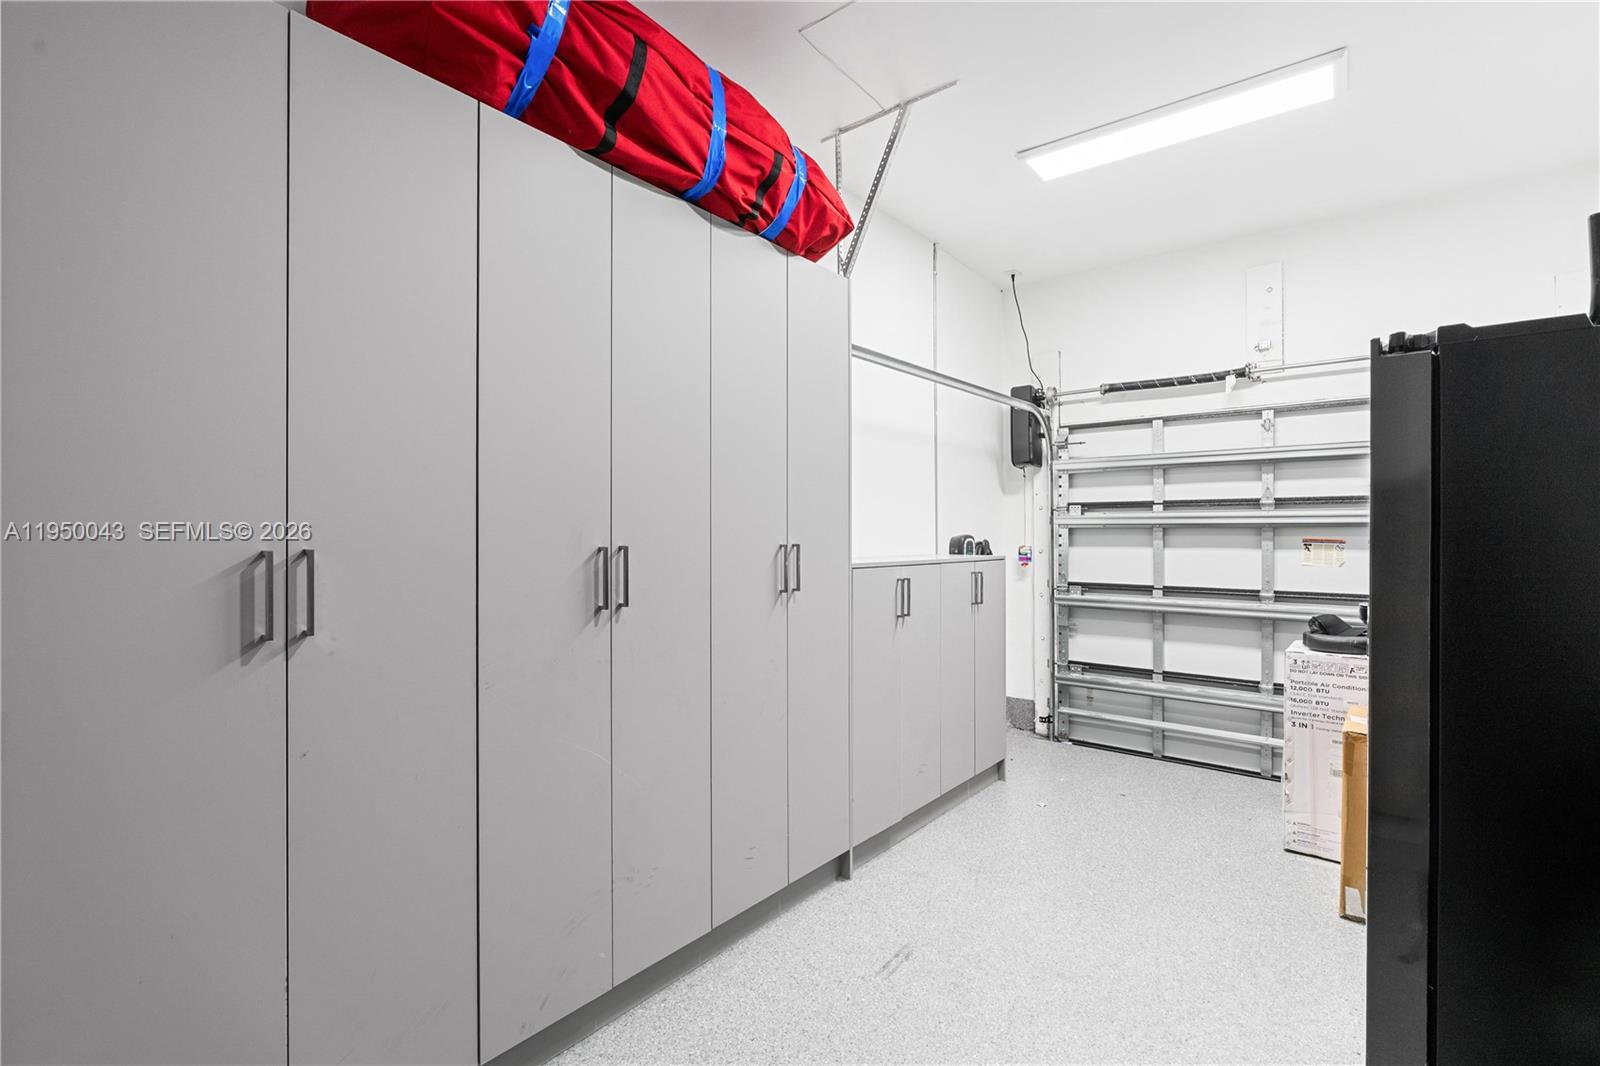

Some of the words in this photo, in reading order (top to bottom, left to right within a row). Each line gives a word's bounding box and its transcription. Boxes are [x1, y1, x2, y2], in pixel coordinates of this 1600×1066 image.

[1290, 679, 1318, 687] Portable
[1291, 710, 1320, 718] Inverter
[1322, 713, 1345, 721] Techn
